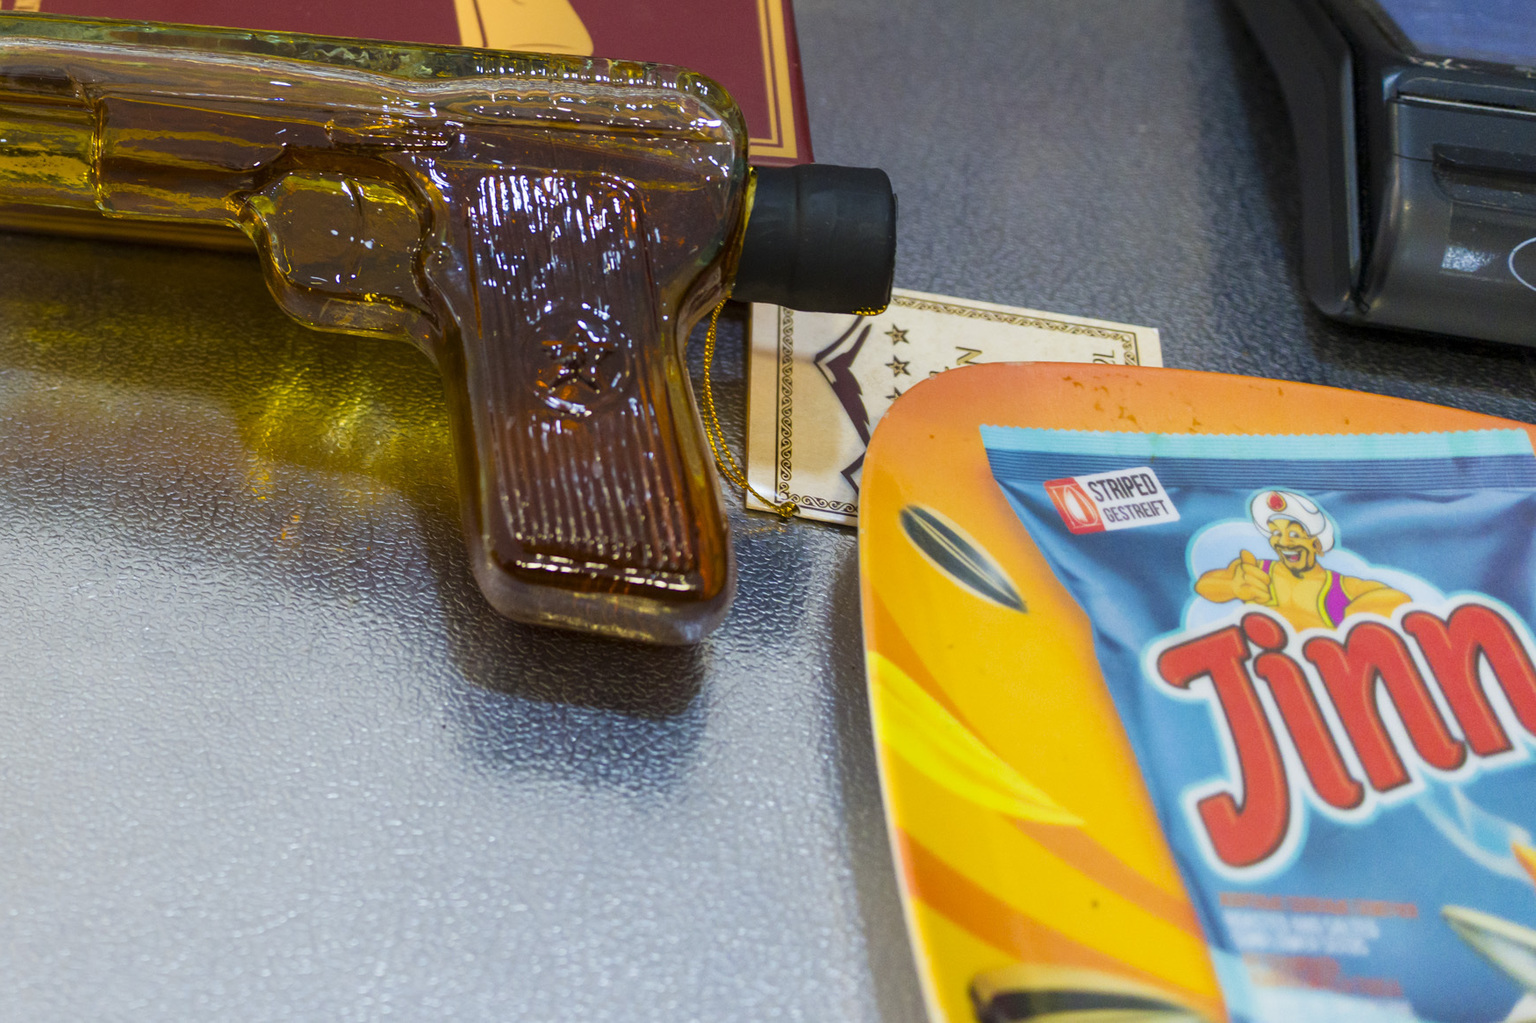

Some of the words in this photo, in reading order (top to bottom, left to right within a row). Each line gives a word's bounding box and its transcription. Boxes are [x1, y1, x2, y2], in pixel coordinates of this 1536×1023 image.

[1087, 473, 1158, 503] STRIPED
[1102, 499, 1170, 523] GESTREIFT
[1157, 602, 1536, 868] Jinn
